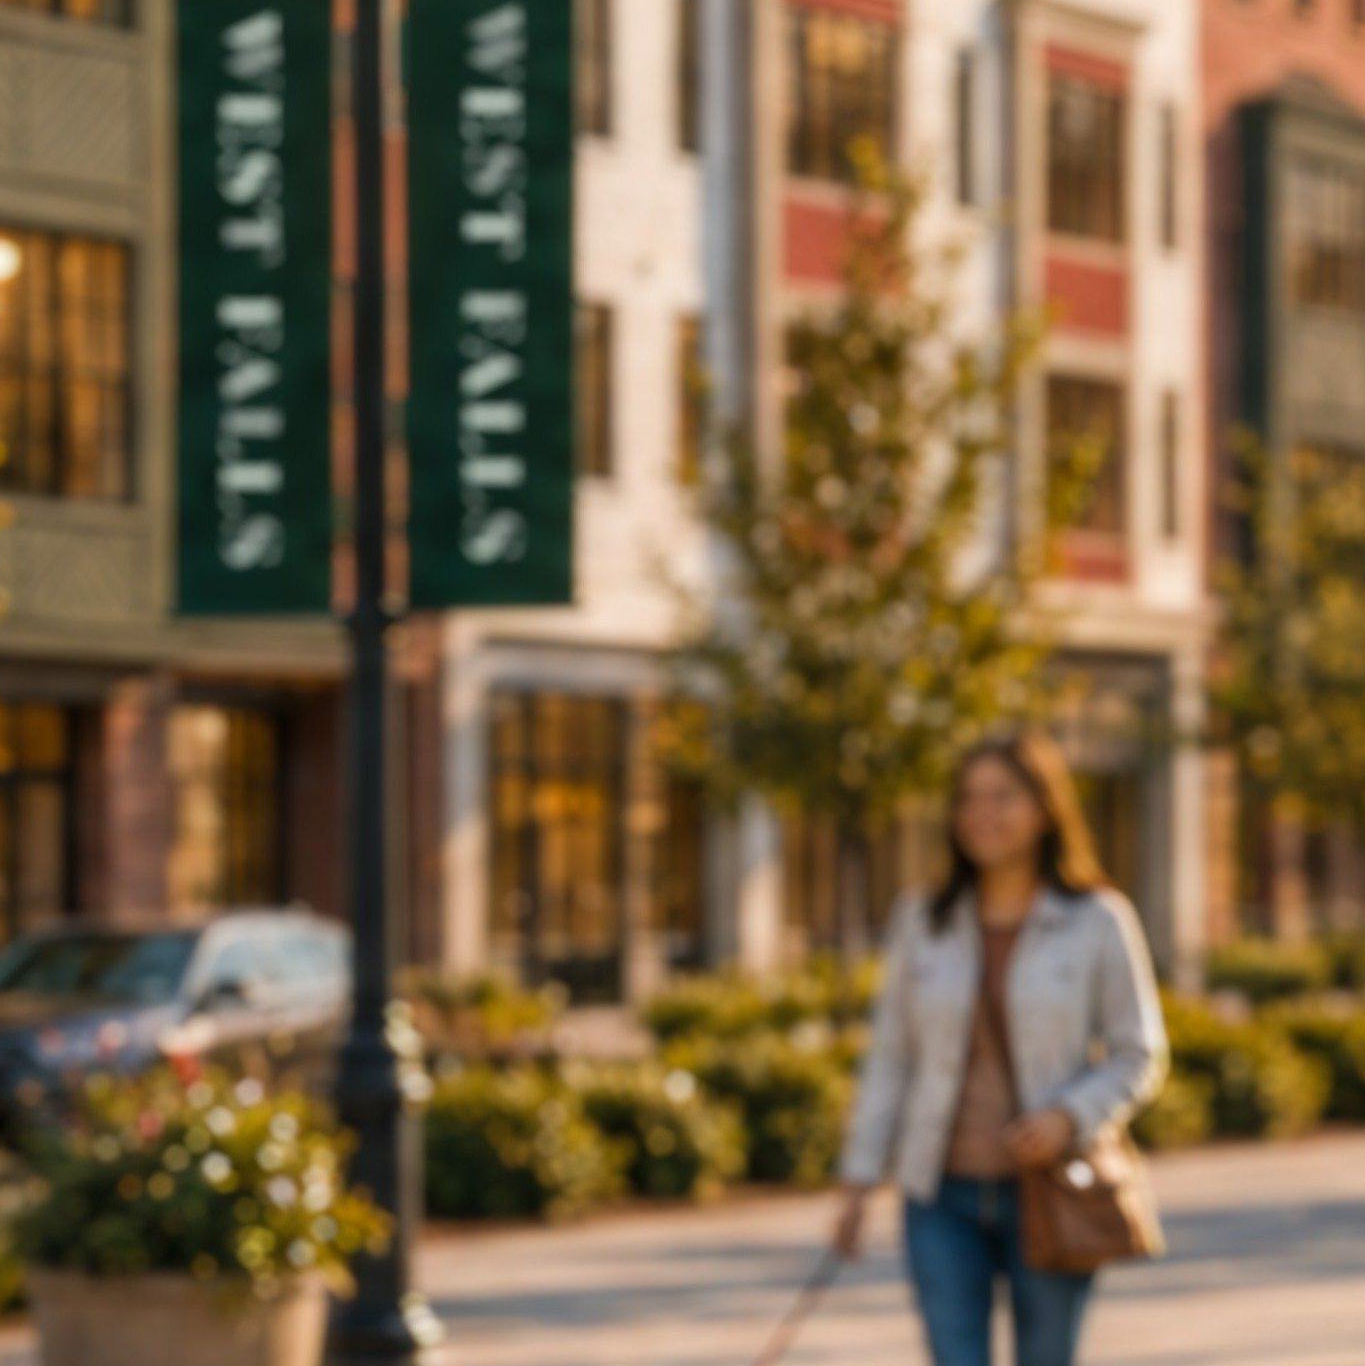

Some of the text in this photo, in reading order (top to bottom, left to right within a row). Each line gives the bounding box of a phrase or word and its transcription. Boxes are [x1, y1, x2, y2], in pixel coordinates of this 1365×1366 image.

[217, 10, 283, 569] WEST FALLS
[459, 3, 526, 564] WEST FALLS
